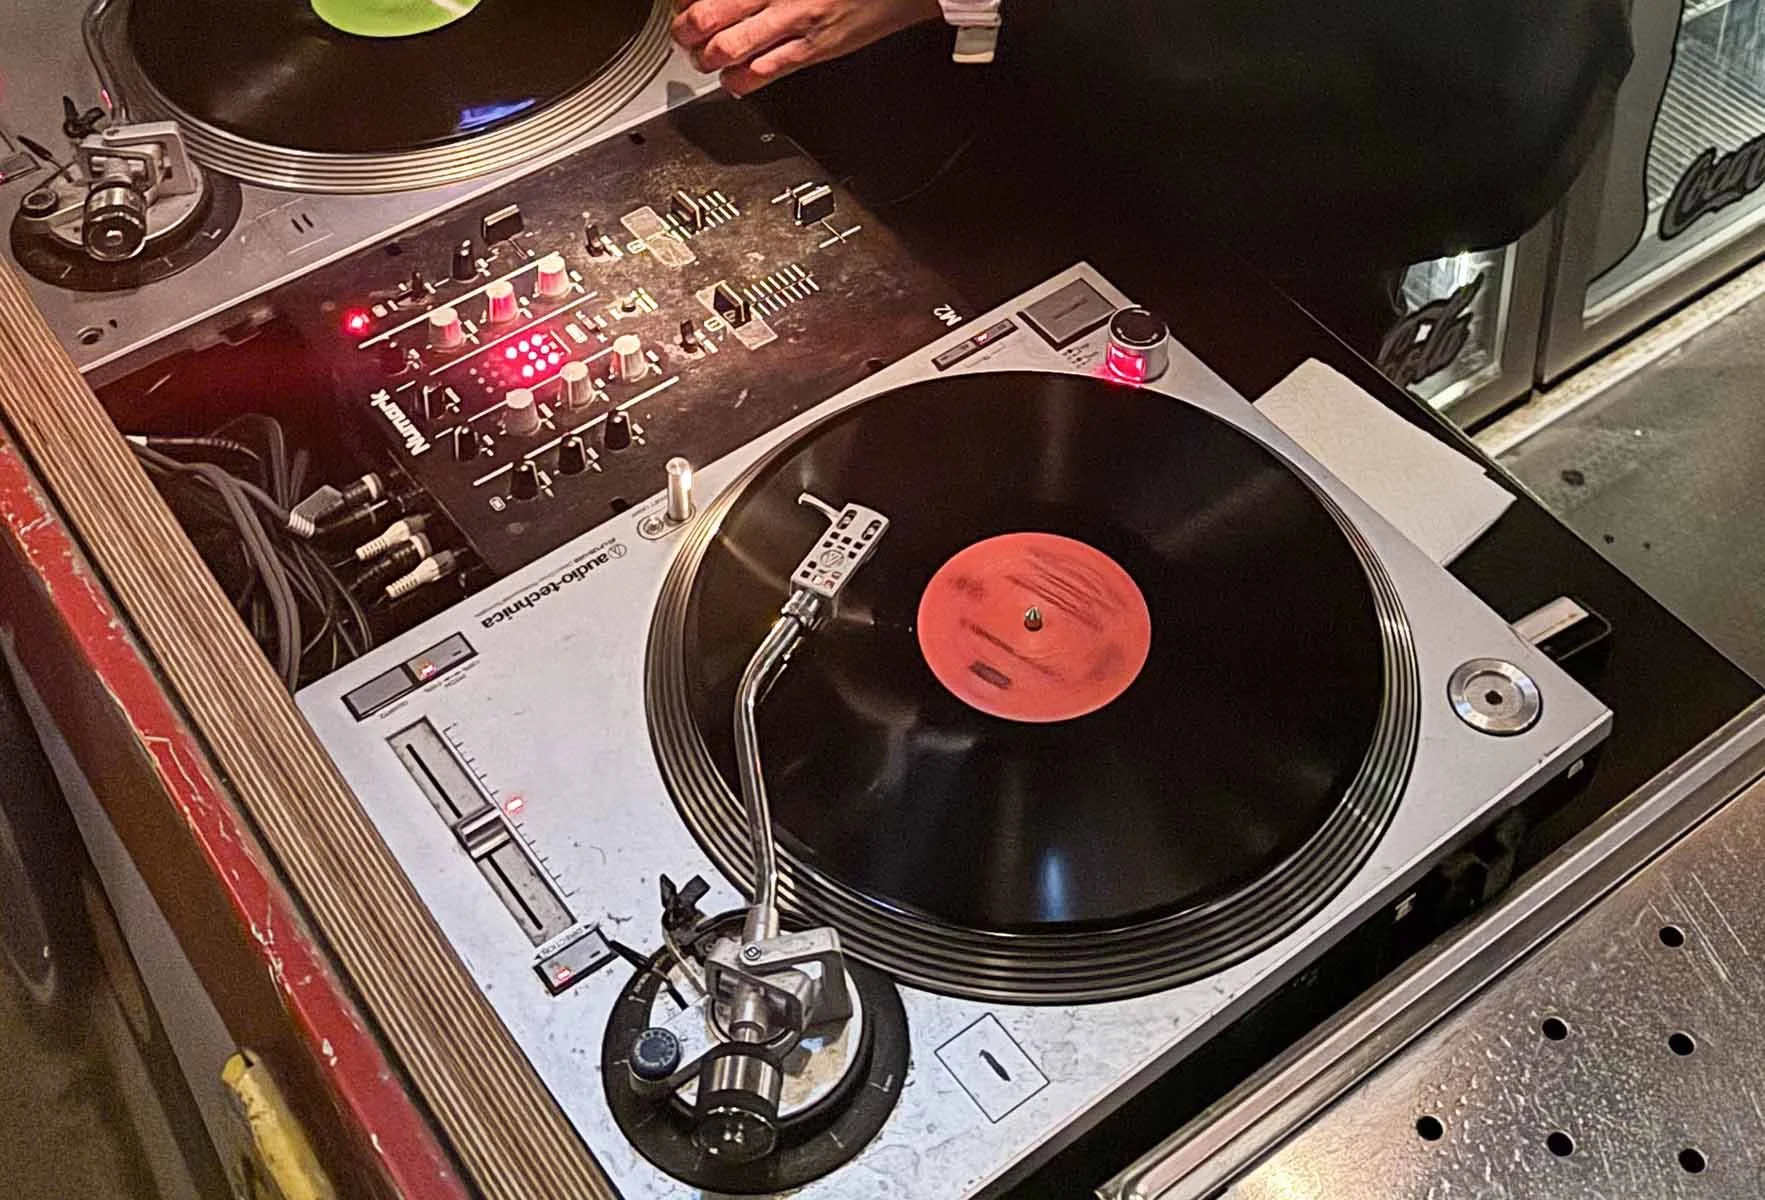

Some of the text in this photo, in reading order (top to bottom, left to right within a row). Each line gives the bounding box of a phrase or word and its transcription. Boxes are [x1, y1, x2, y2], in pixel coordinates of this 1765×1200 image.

[933, 303, 963, 327] M2
[370, 389, 431, 456] Numark
[481, 554, 609, 629] audio-technica
